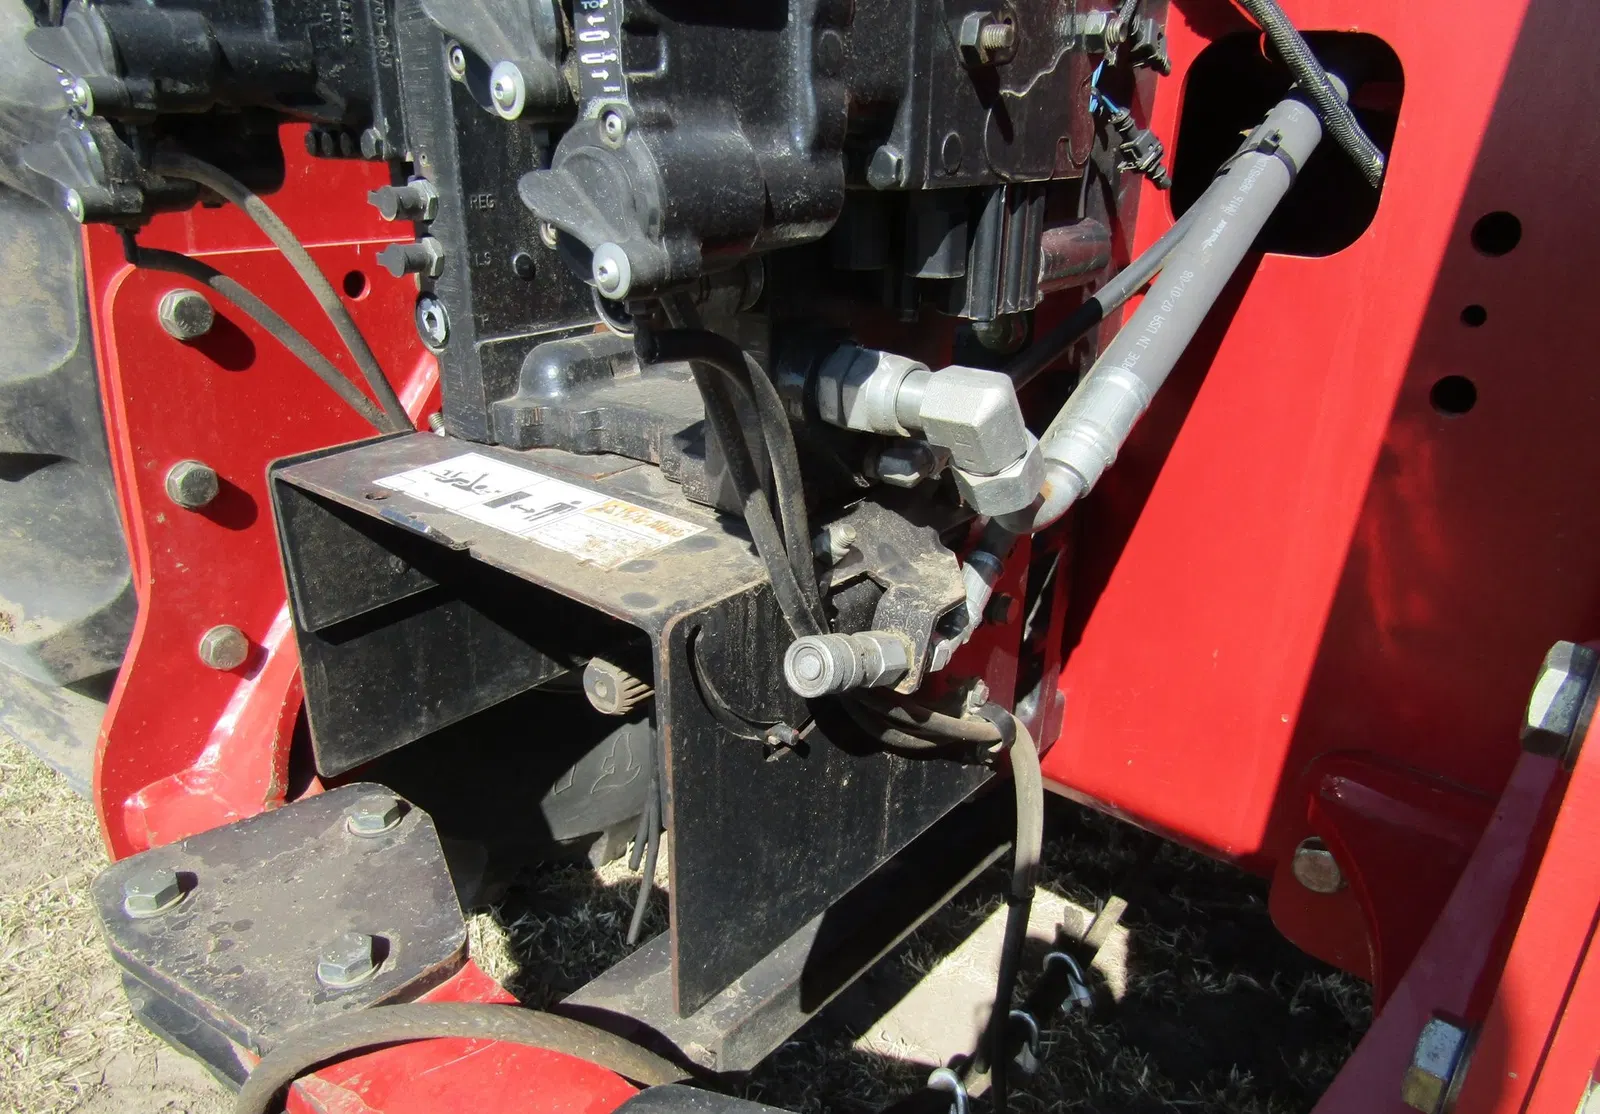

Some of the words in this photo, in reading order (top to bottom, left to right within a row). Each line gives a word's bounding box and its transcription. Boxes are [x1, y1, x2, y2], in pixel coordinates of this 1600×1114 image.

[470, 193, 495, 209] REG
[474, 251, 492, 267] LS
[1121, 351, 1141, 373] ADE
[1136, 335, 1152, 350] IN
[1145, 314, 1166, 334] USA
[1161, 270, 1194, 312] 07/01/08
